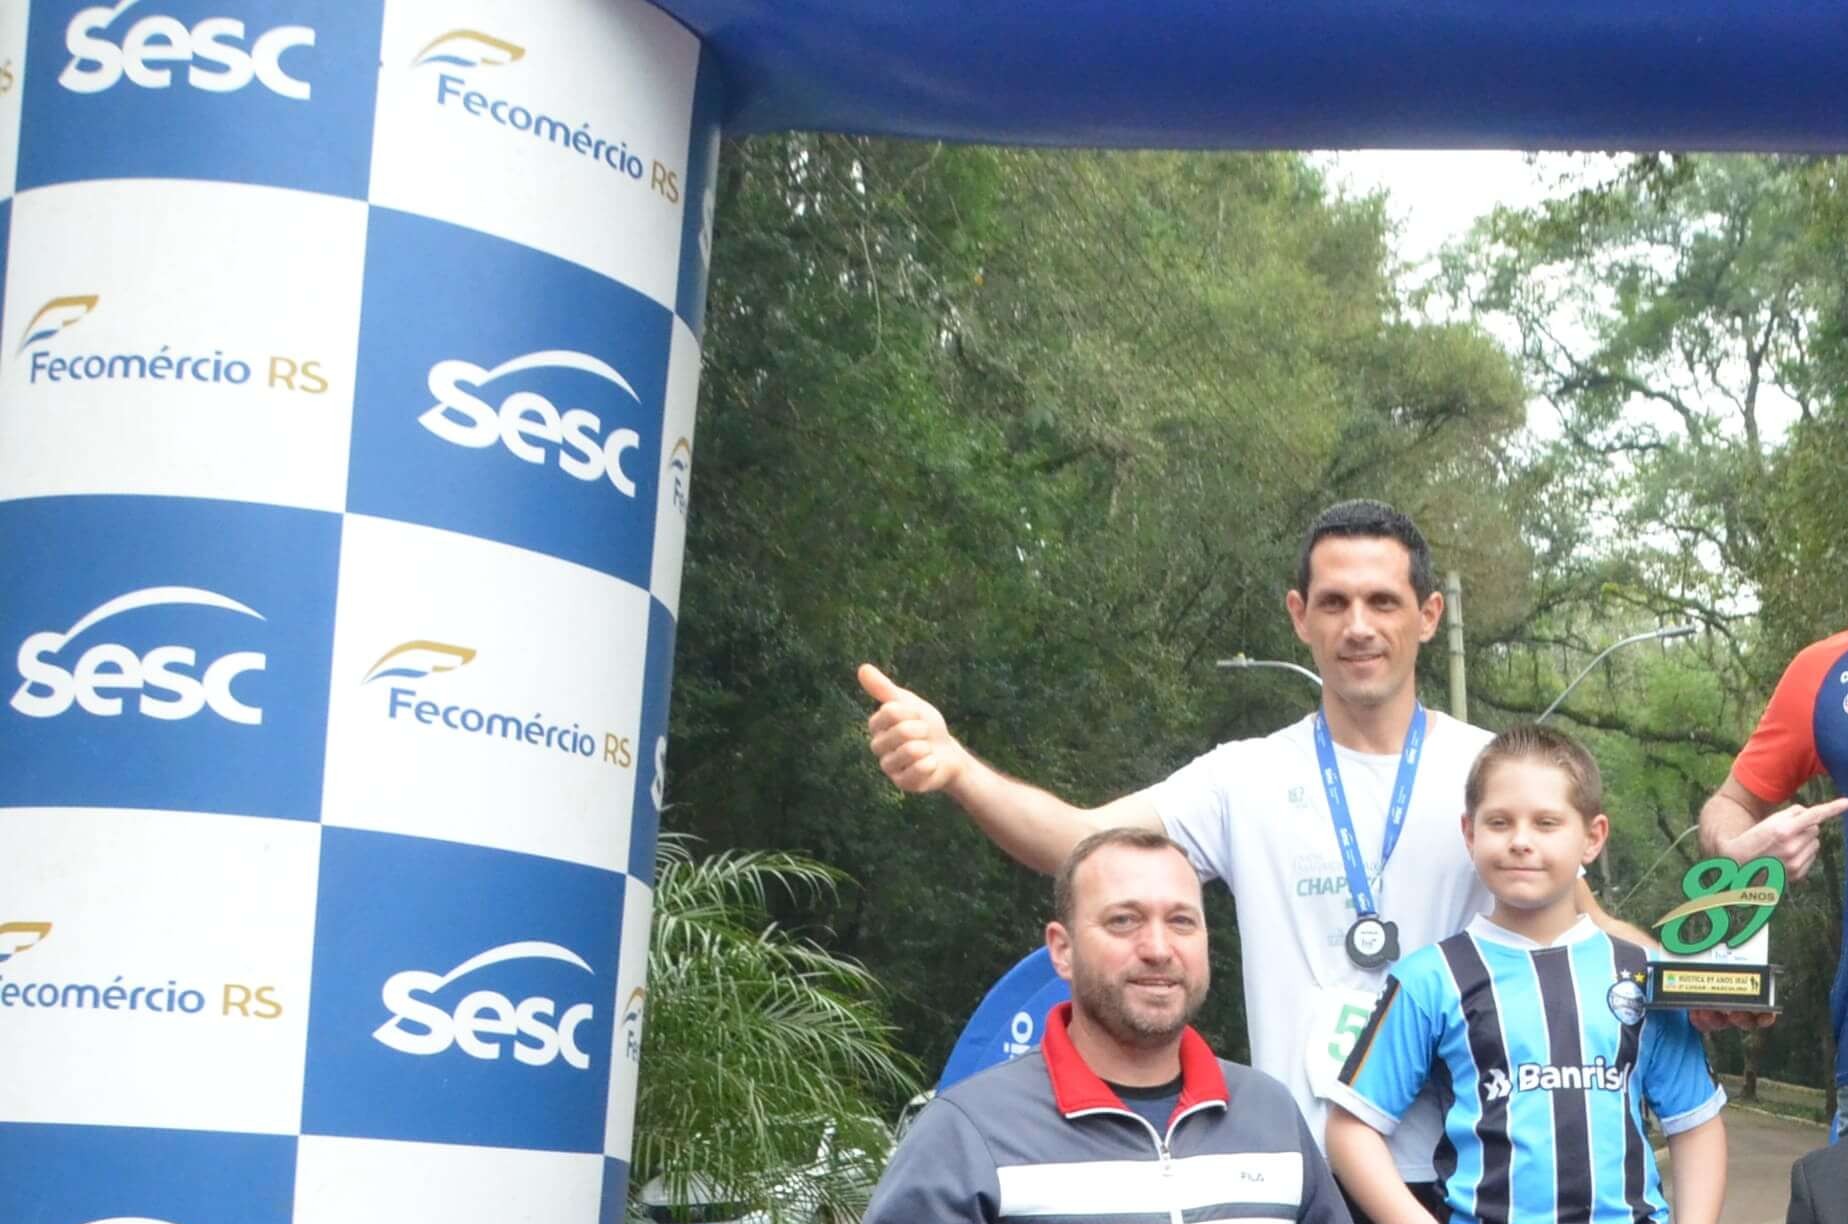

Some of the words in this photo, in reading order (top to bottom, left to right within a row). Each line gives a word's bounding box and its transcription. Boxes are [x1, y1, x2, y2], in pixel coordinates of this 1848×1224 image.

[436, 72, 644, 182] Fecomércio
[651, 160, 680, 205] RS
[29, 346, 251, 387] Fecomércio
[267, 356, 329, 395] RS
[389, 687, 596, 758] Fecomércio
[603, 732, 632, 770] RS
[1661, 857, 1786, 955] 89
[1740, 890, 1776, 901] ANOS
[0, 975, 206, 1014] ecomércio
[221, 983, 284, 1020] RS
